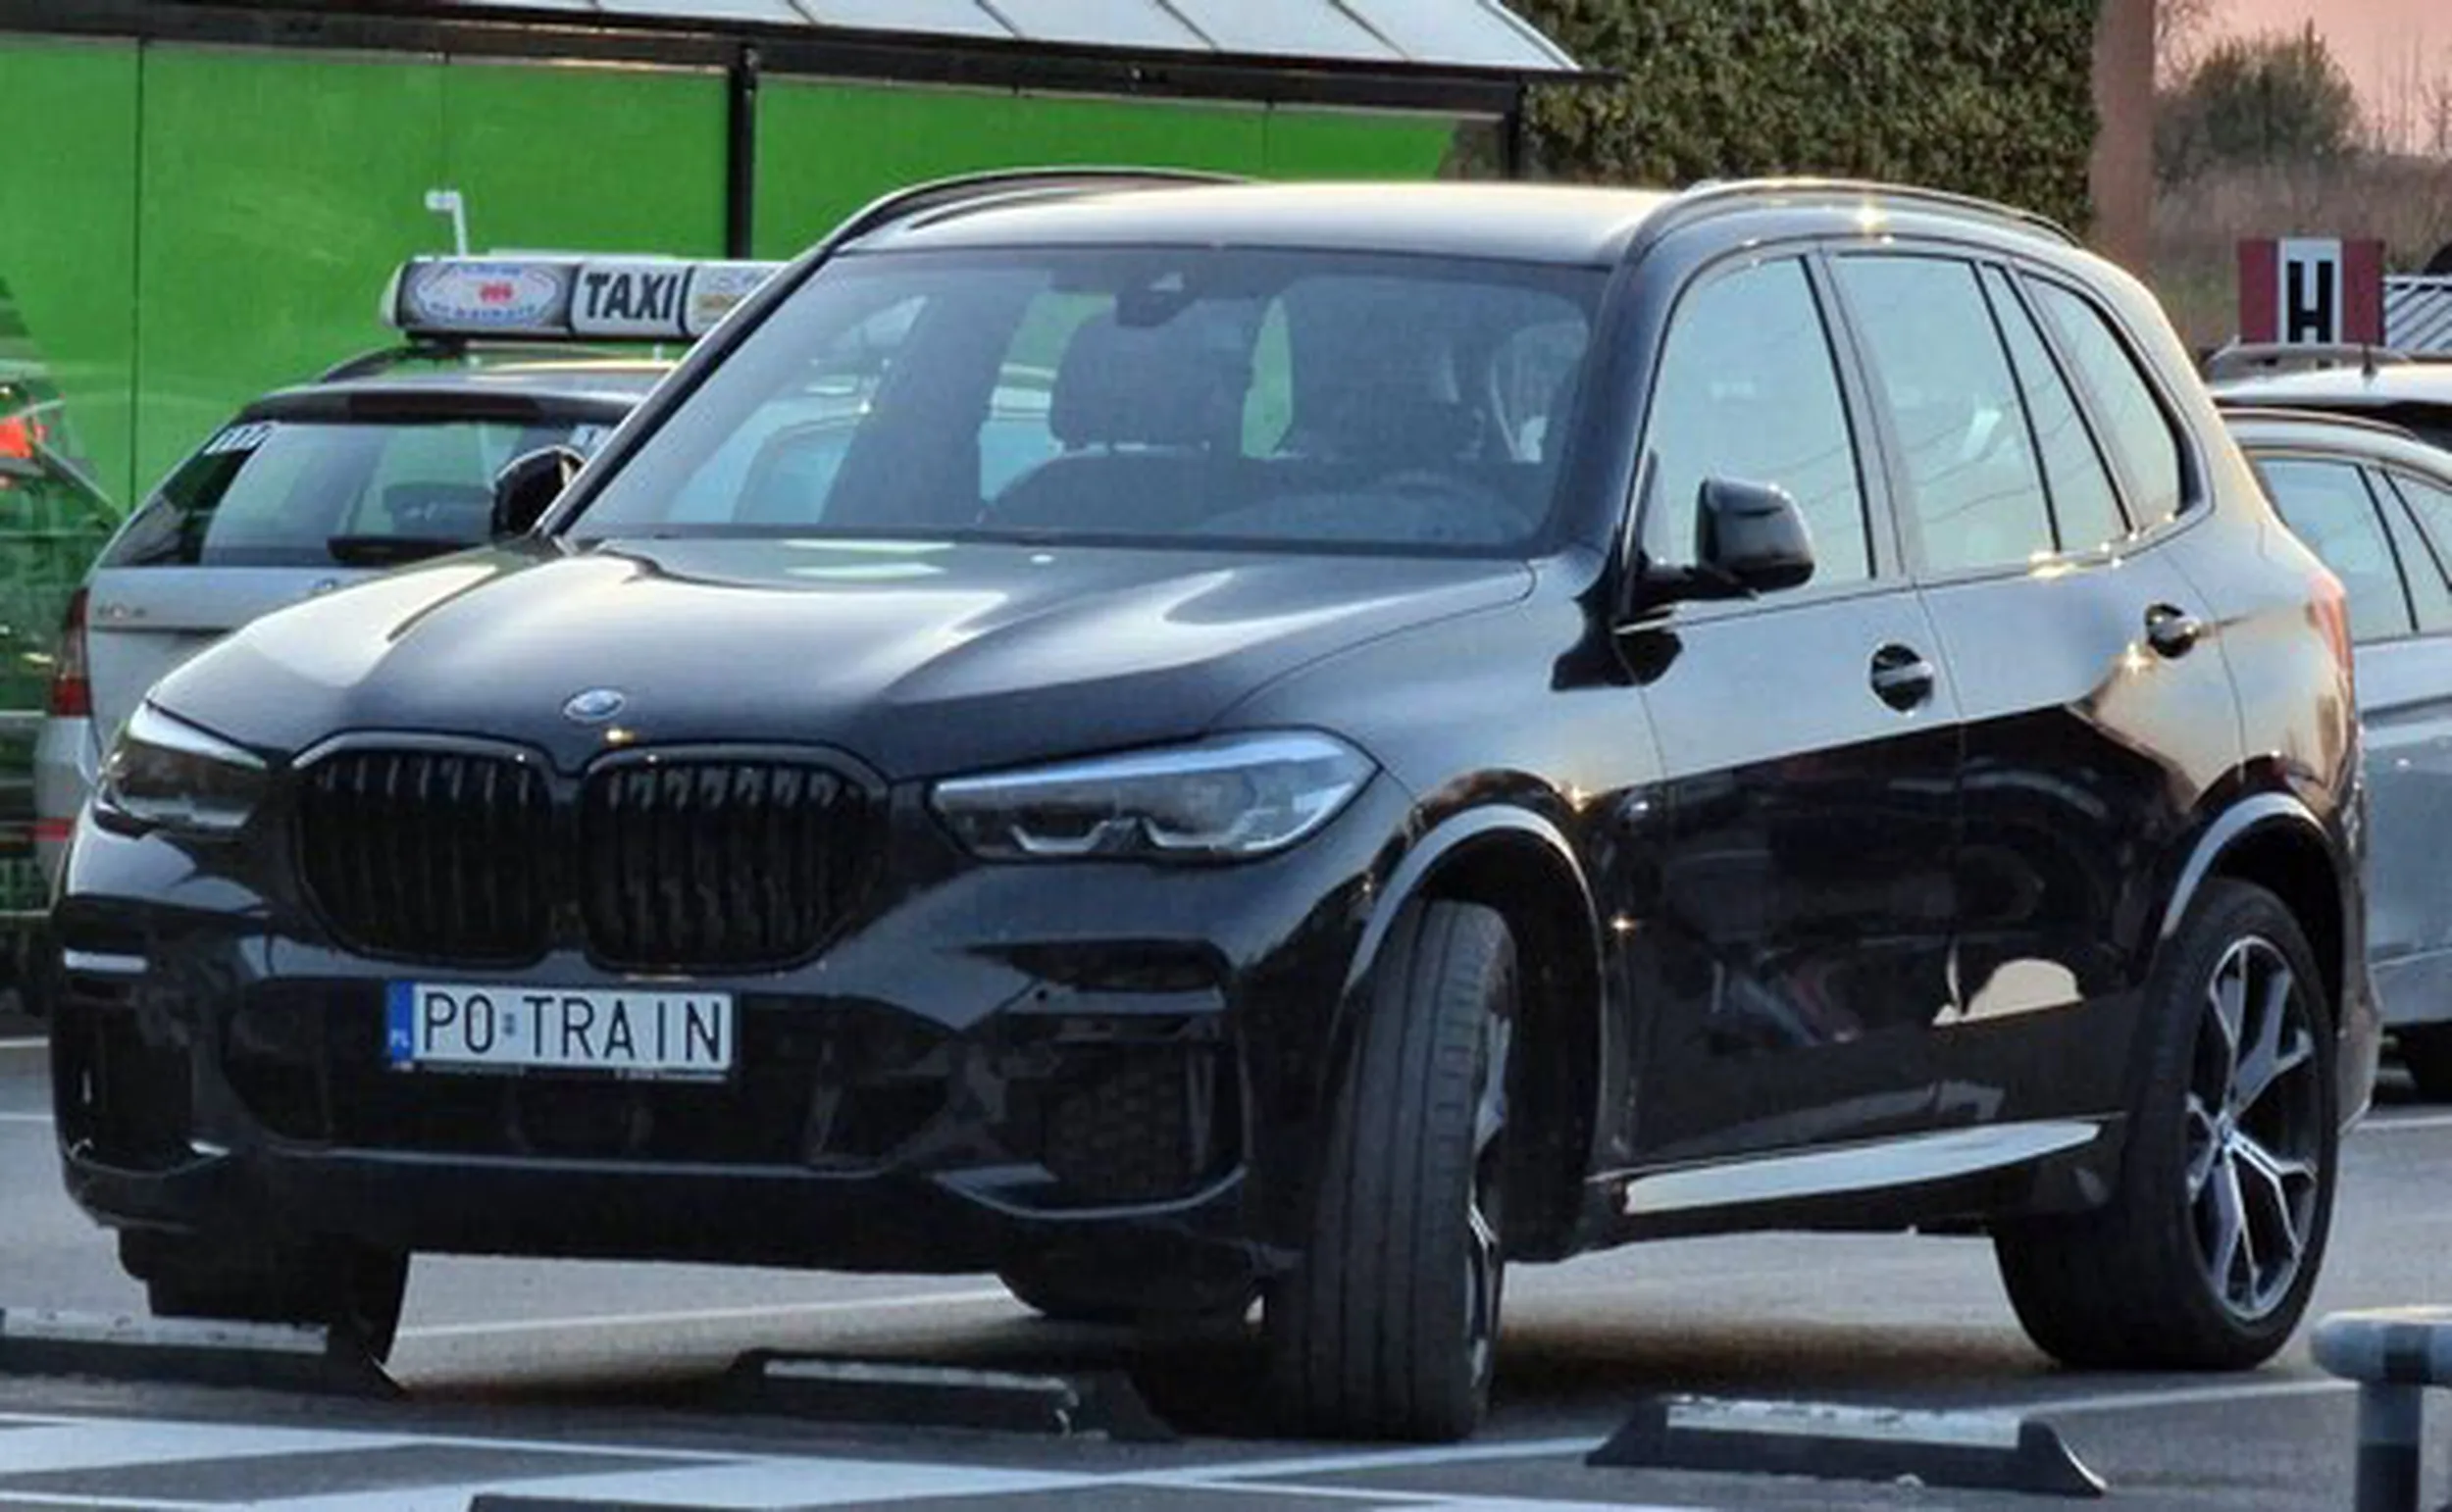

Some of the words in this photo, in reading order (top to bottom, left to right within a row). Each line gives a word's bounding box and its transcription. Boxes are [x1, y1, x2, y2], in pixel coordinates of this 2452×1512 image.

[586, 272, 680, 320] TAXI
[2287, 261, 2333, 342] H
[424, 991, 495, 1054] PO
[524, 995, 722, 1063] TRAIN
